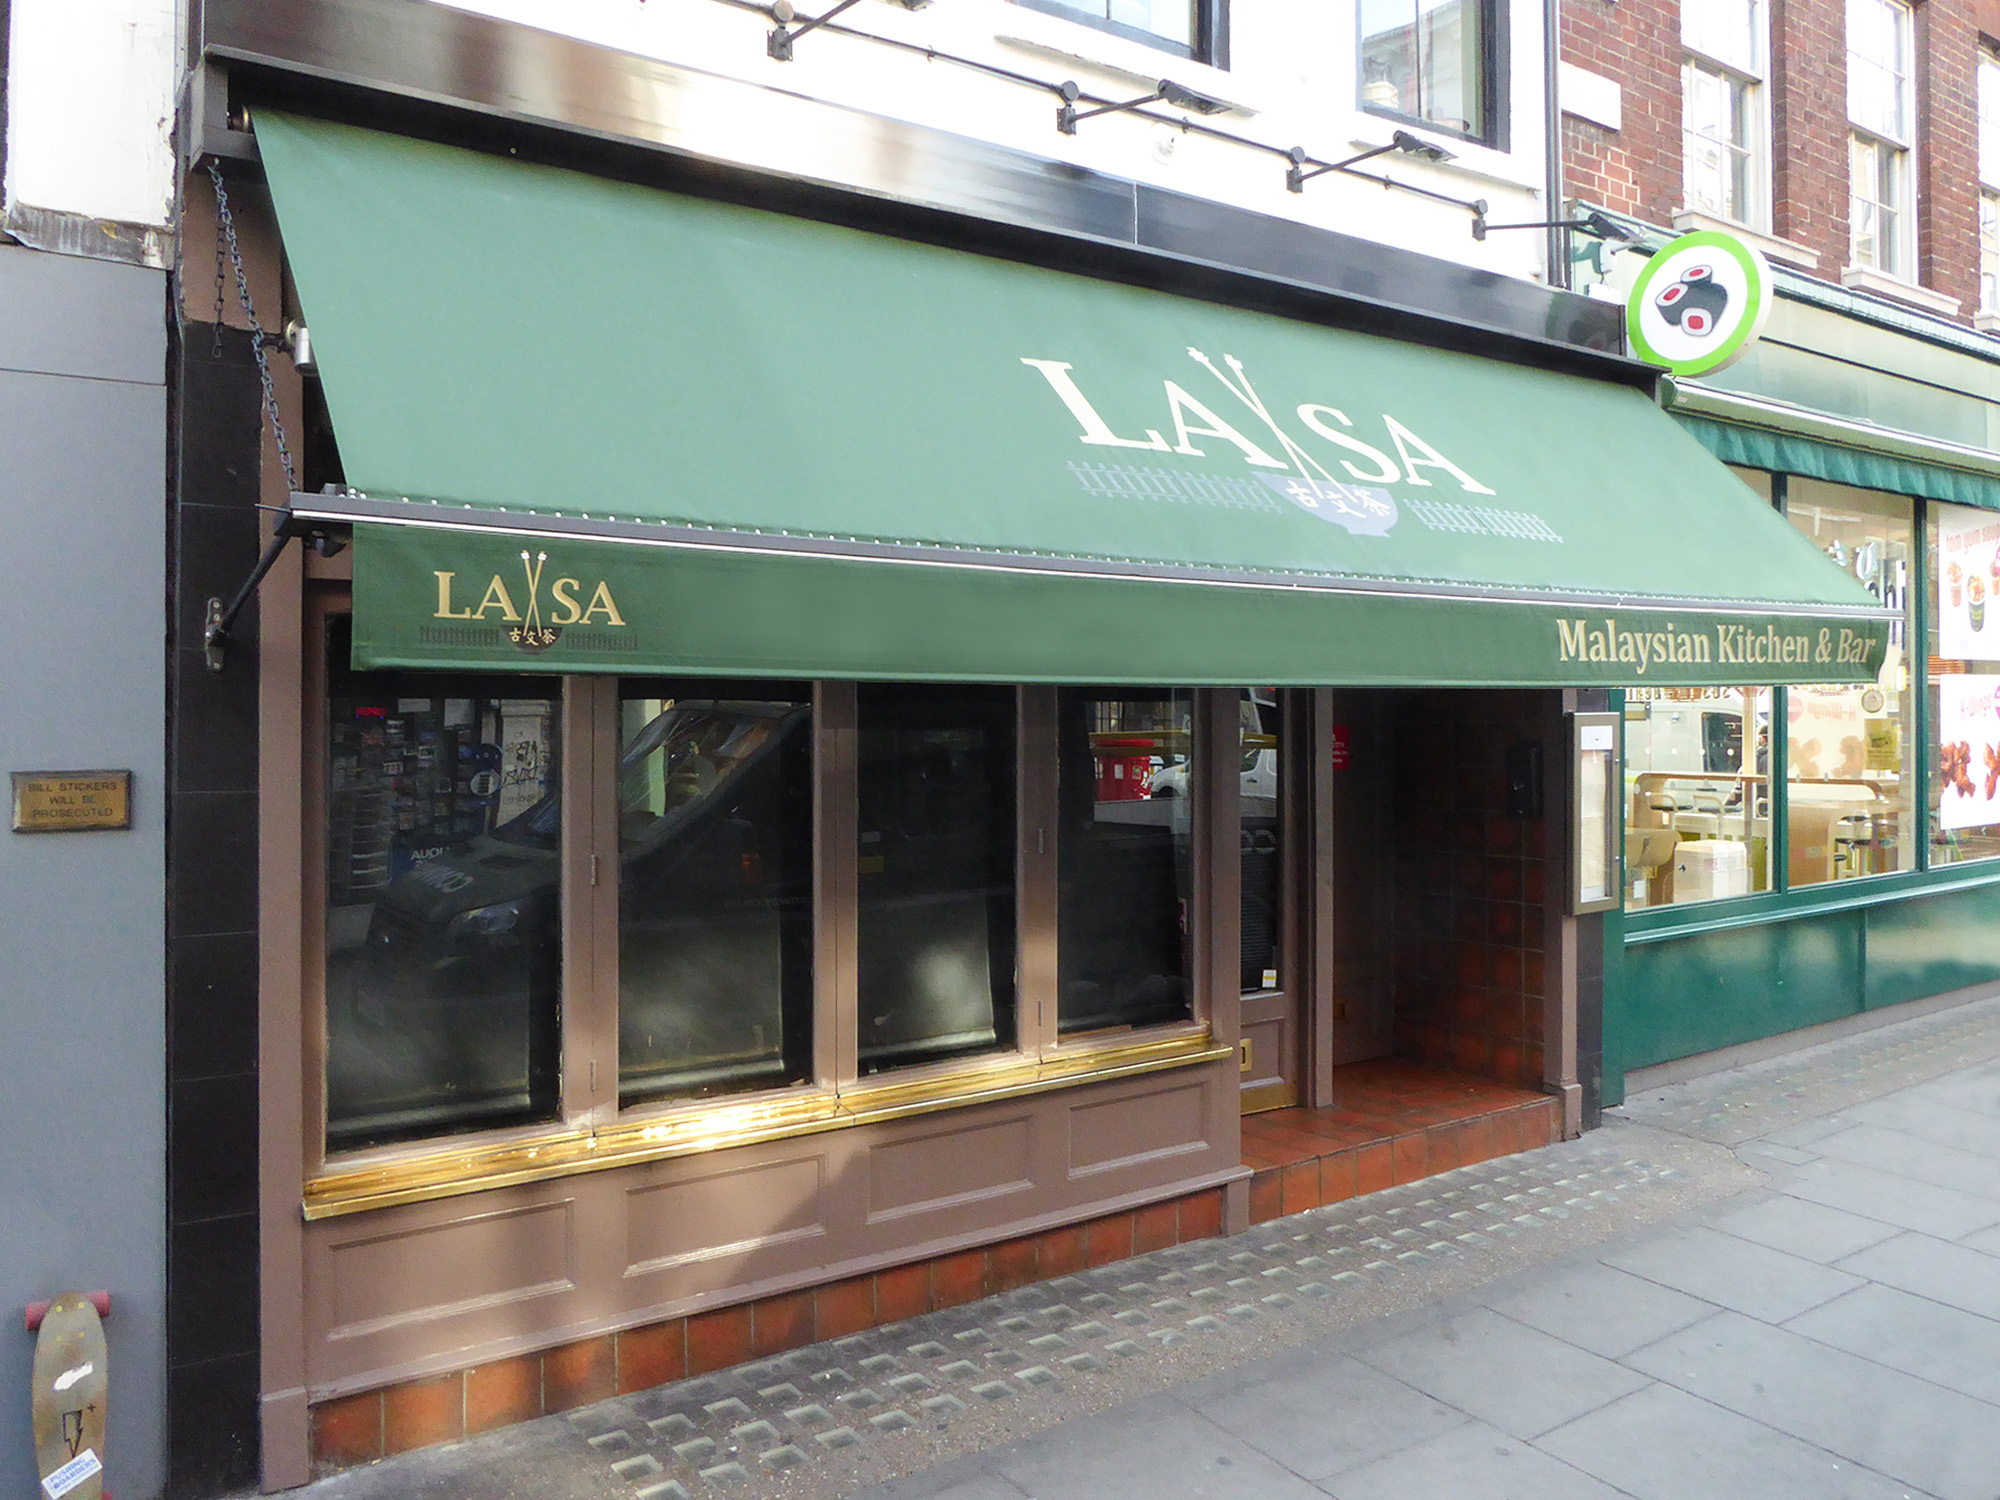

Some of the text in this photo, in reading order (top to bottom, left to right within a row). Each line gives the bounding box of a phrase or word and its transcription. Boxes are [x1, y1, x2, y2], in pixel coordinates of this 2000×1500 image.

[1557, 619, 1877, 674] Malaysian Kitchen & Bar
[28, 782, 118, 792] BILL STICKERS
[50, 795, 97, 805] WILL BE
[33, 808, 113, 818] PROSECUTED
[50, 1457, 85, 1483] PUSHING
[53, 1459, 96, 1489] BOARDERS
